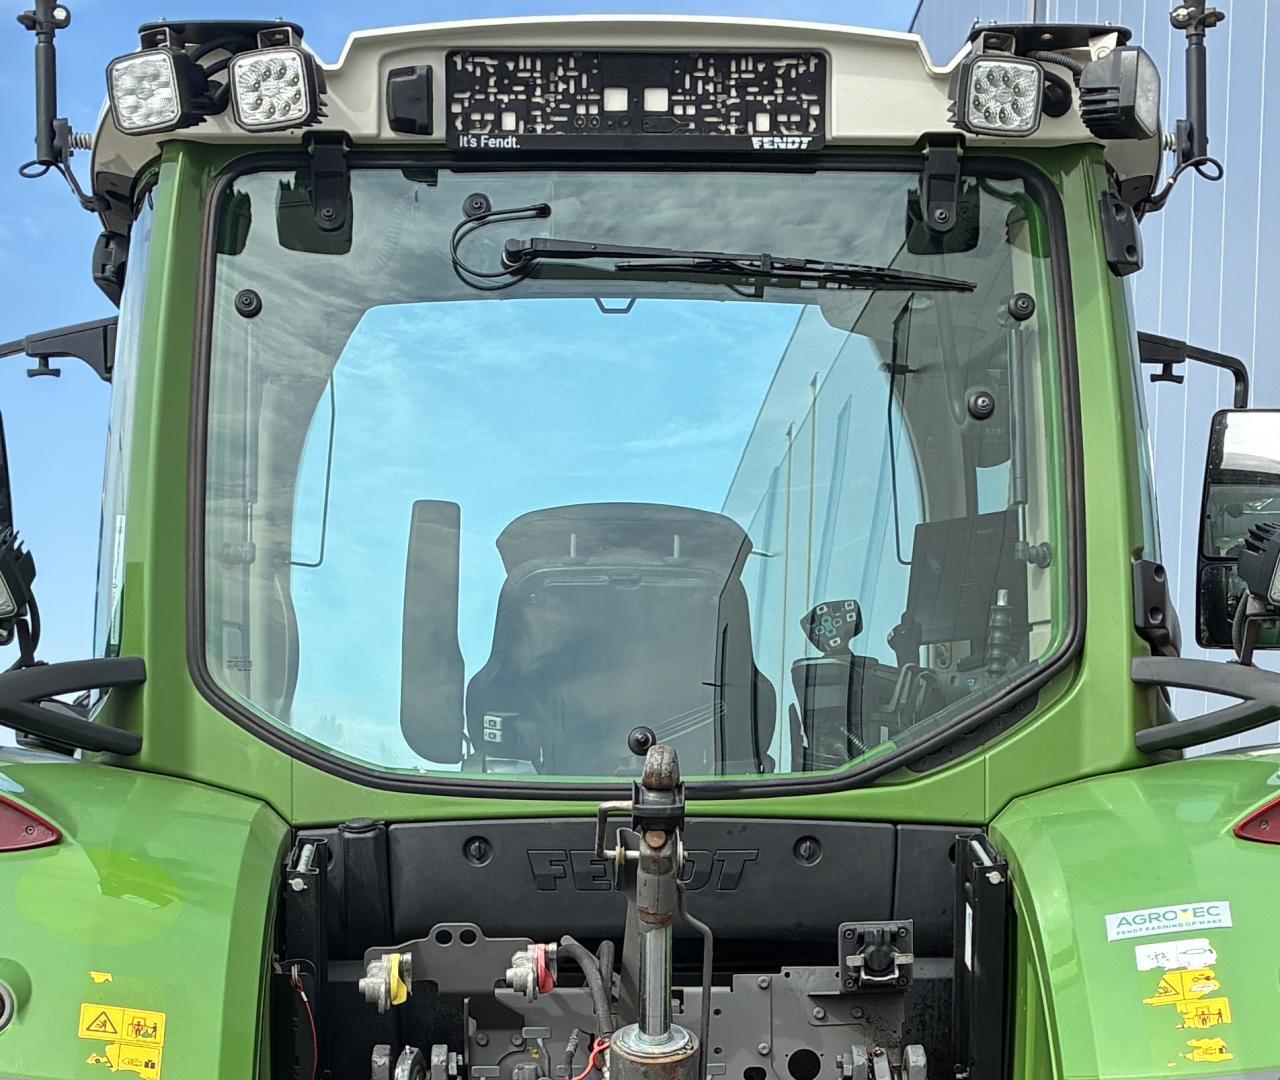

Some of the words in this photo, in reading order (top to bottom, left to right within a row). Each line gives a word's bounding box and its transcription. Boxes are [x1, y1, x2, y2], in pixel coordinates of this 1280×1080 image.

[459, 134, 477, 148] It's
[481, 134, 521, 148] Fendt.
[752, 136, 813, 149] FENDT
[527, 849, 760, 892] FEDT
